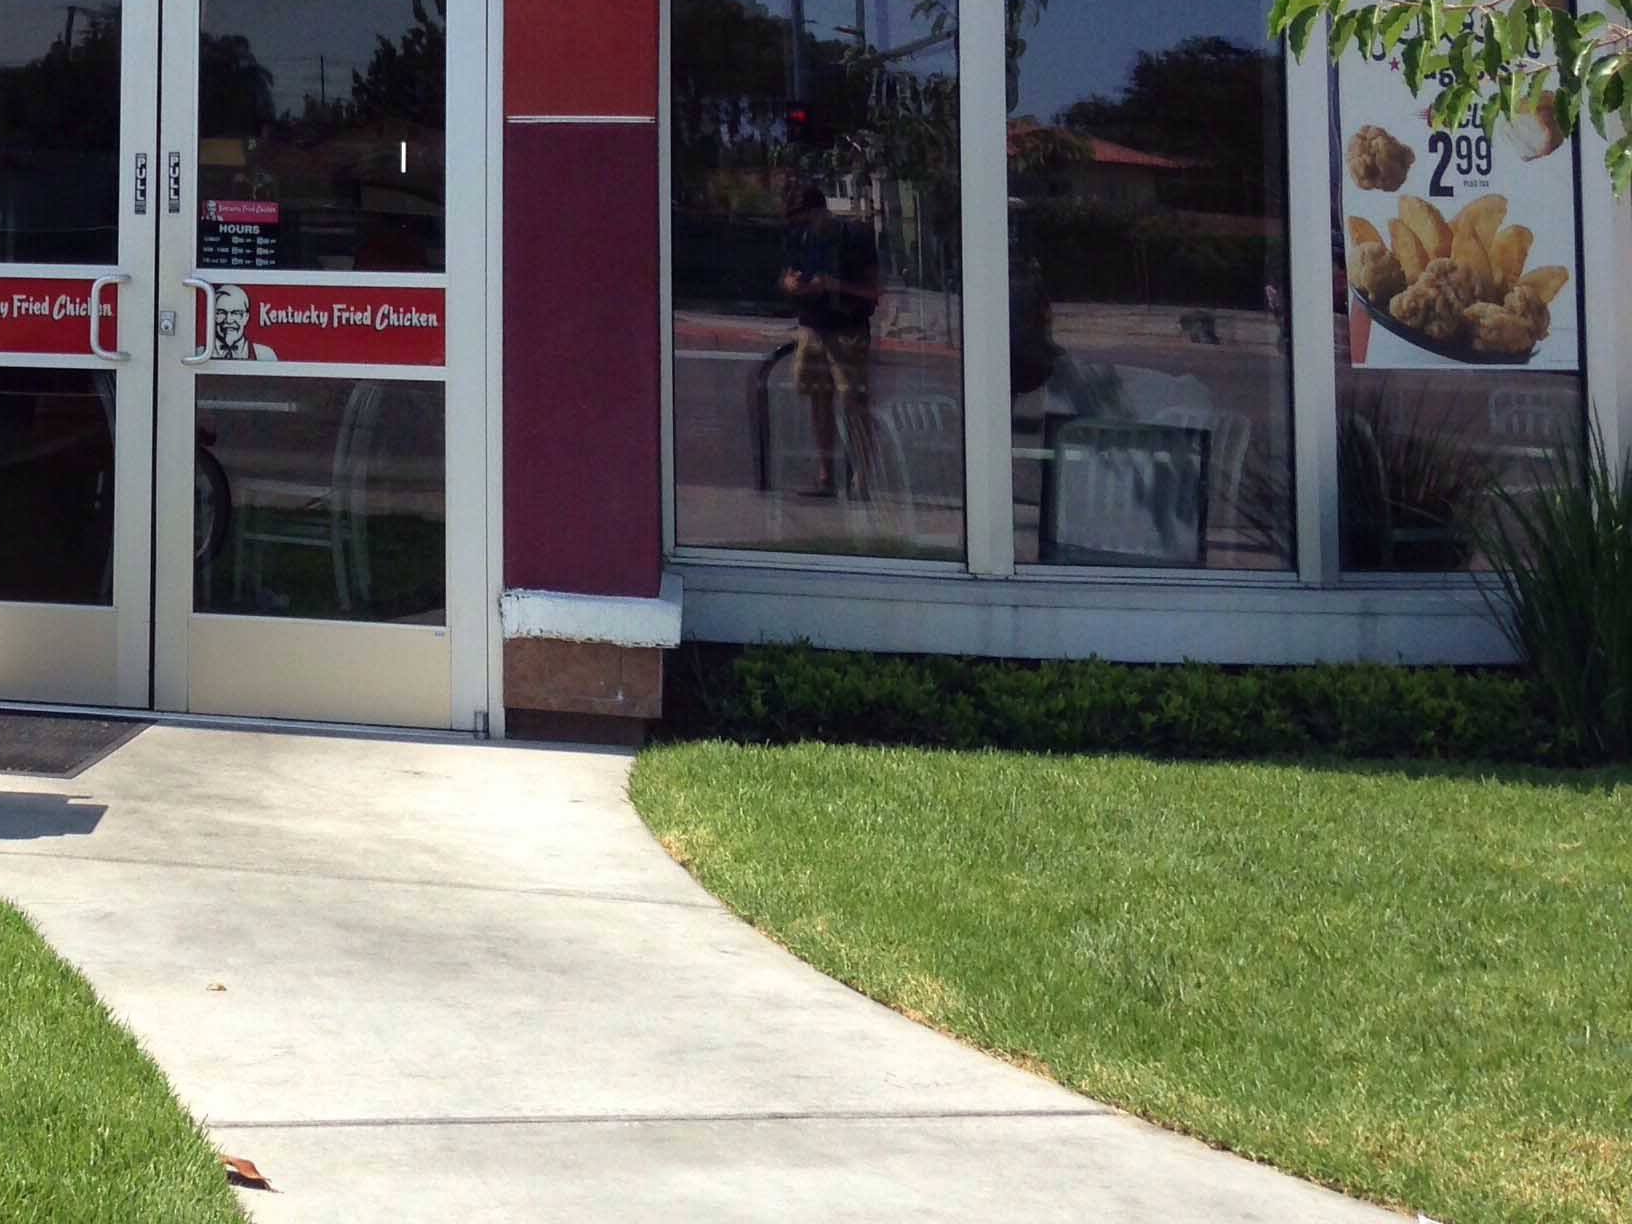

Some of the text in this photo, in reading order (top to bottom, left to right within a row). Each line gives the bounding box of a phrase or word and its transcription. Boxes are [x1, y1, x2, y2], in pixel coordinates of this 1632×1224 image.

[136, 157, 146, 201] PULL
[170, 155, 179, 200] PULL
[218, 223, 261, 235] HOURS
[12, 294, 49, 318] Fried
[52, 293, 112, 321] Chicen
[259, 302, 438, 331] Kentucky Fried Chicken
